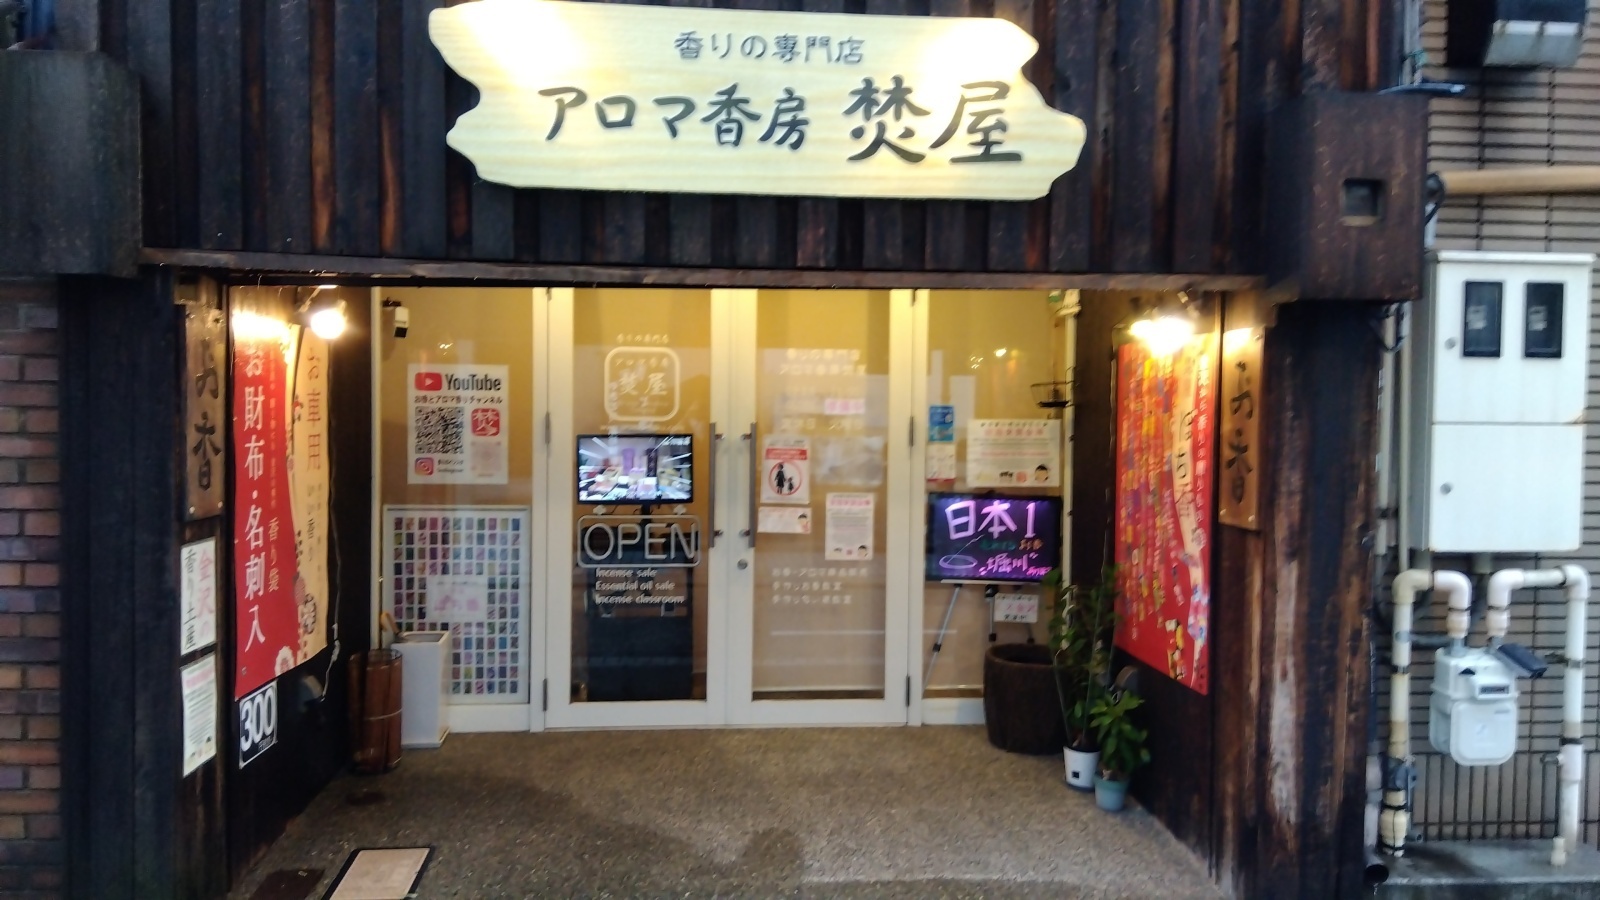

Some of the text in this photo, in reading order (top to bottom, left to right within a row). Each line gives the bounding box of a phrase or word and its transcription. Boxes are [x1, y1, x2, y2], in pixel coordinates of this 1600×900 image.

[673, 30, 866, 65] 香りの専門店
[537, 75, 1023, 164] アロマ香房 焚屋
[445, 373, 502, 391] YouTube
[944, 500, 1037, 540] 日本1
[584, 522, 697, 561] OPEN
[595, 567, 657, 578] Incense sale
[595, 580, 676, 591] Essential oil sale
[595, 594, 685, 604] Incense classroom
[241, 685, 276, 752] 300
